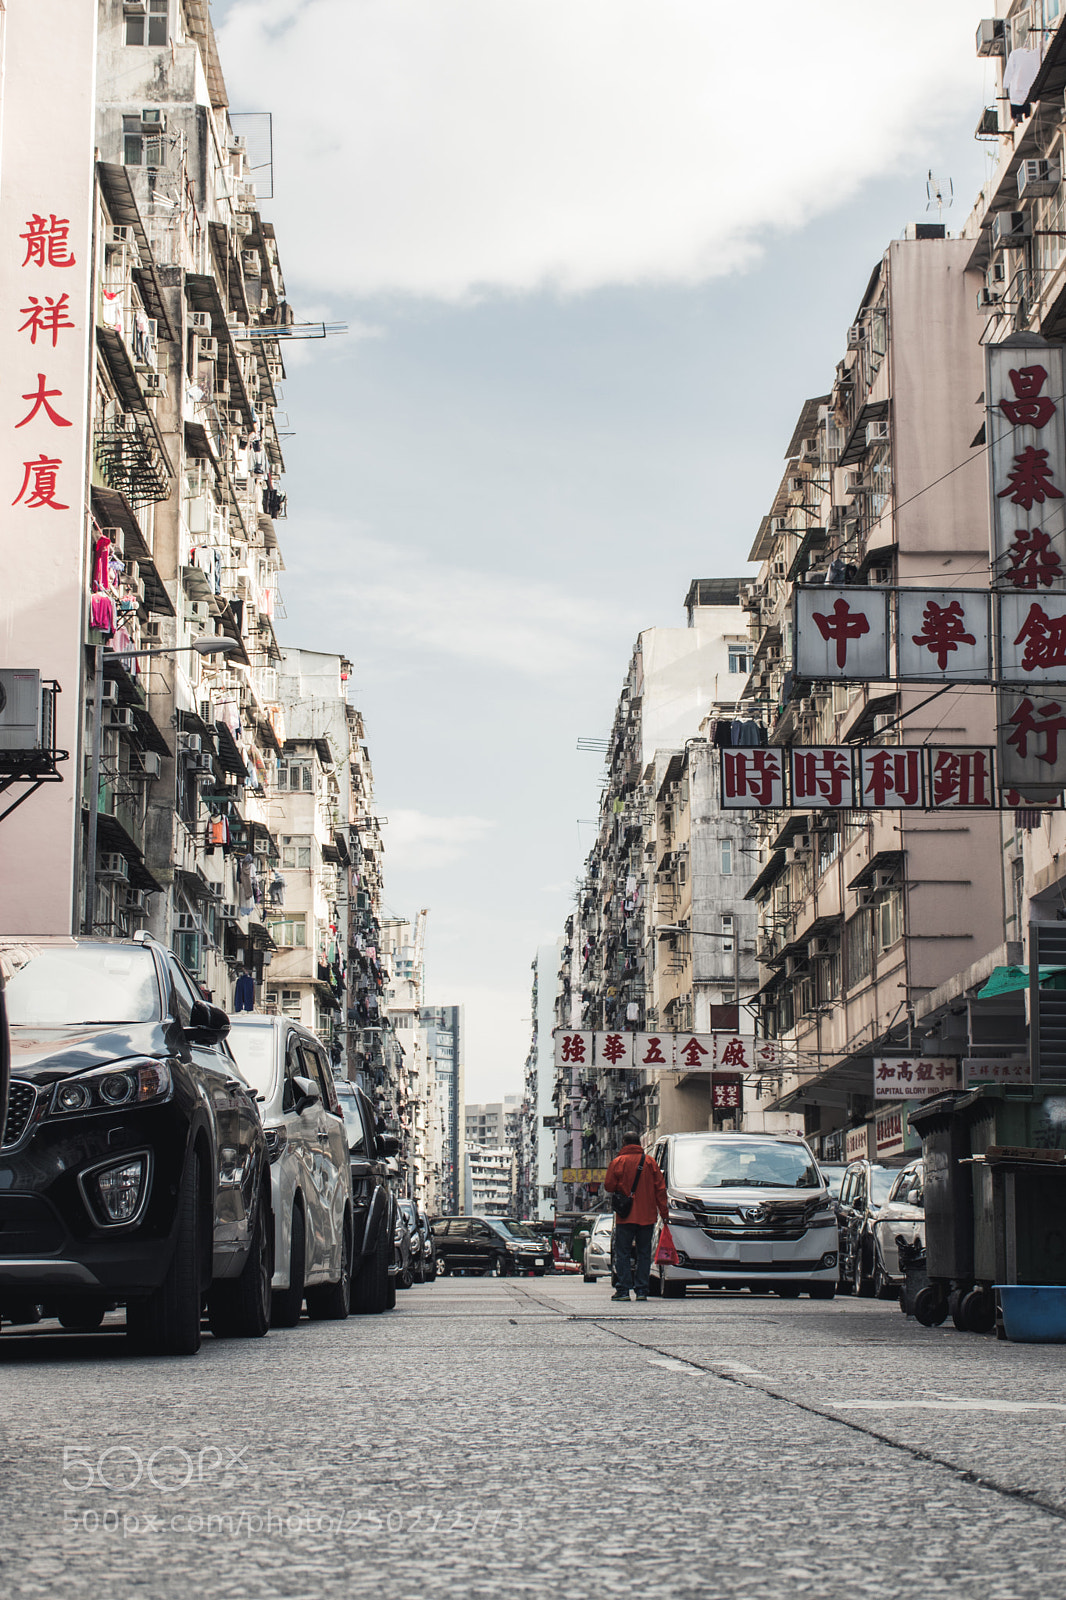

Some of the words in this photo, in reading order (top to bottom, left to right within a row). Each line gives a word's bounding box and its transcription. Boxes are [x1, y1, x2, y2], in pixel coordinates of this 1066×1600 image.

[12, 213, 77, 511] 龍祥大廈
[997, 364, 1066, 765] 昌泰染行
[725, 748, 1058, 806] 時時利鈕
[876, 1061, 955, 1083] 加高鈕扣
[876, 1087, 904, 1095] CAPITAL
[905, 1087, 926, 1095] GLORY
